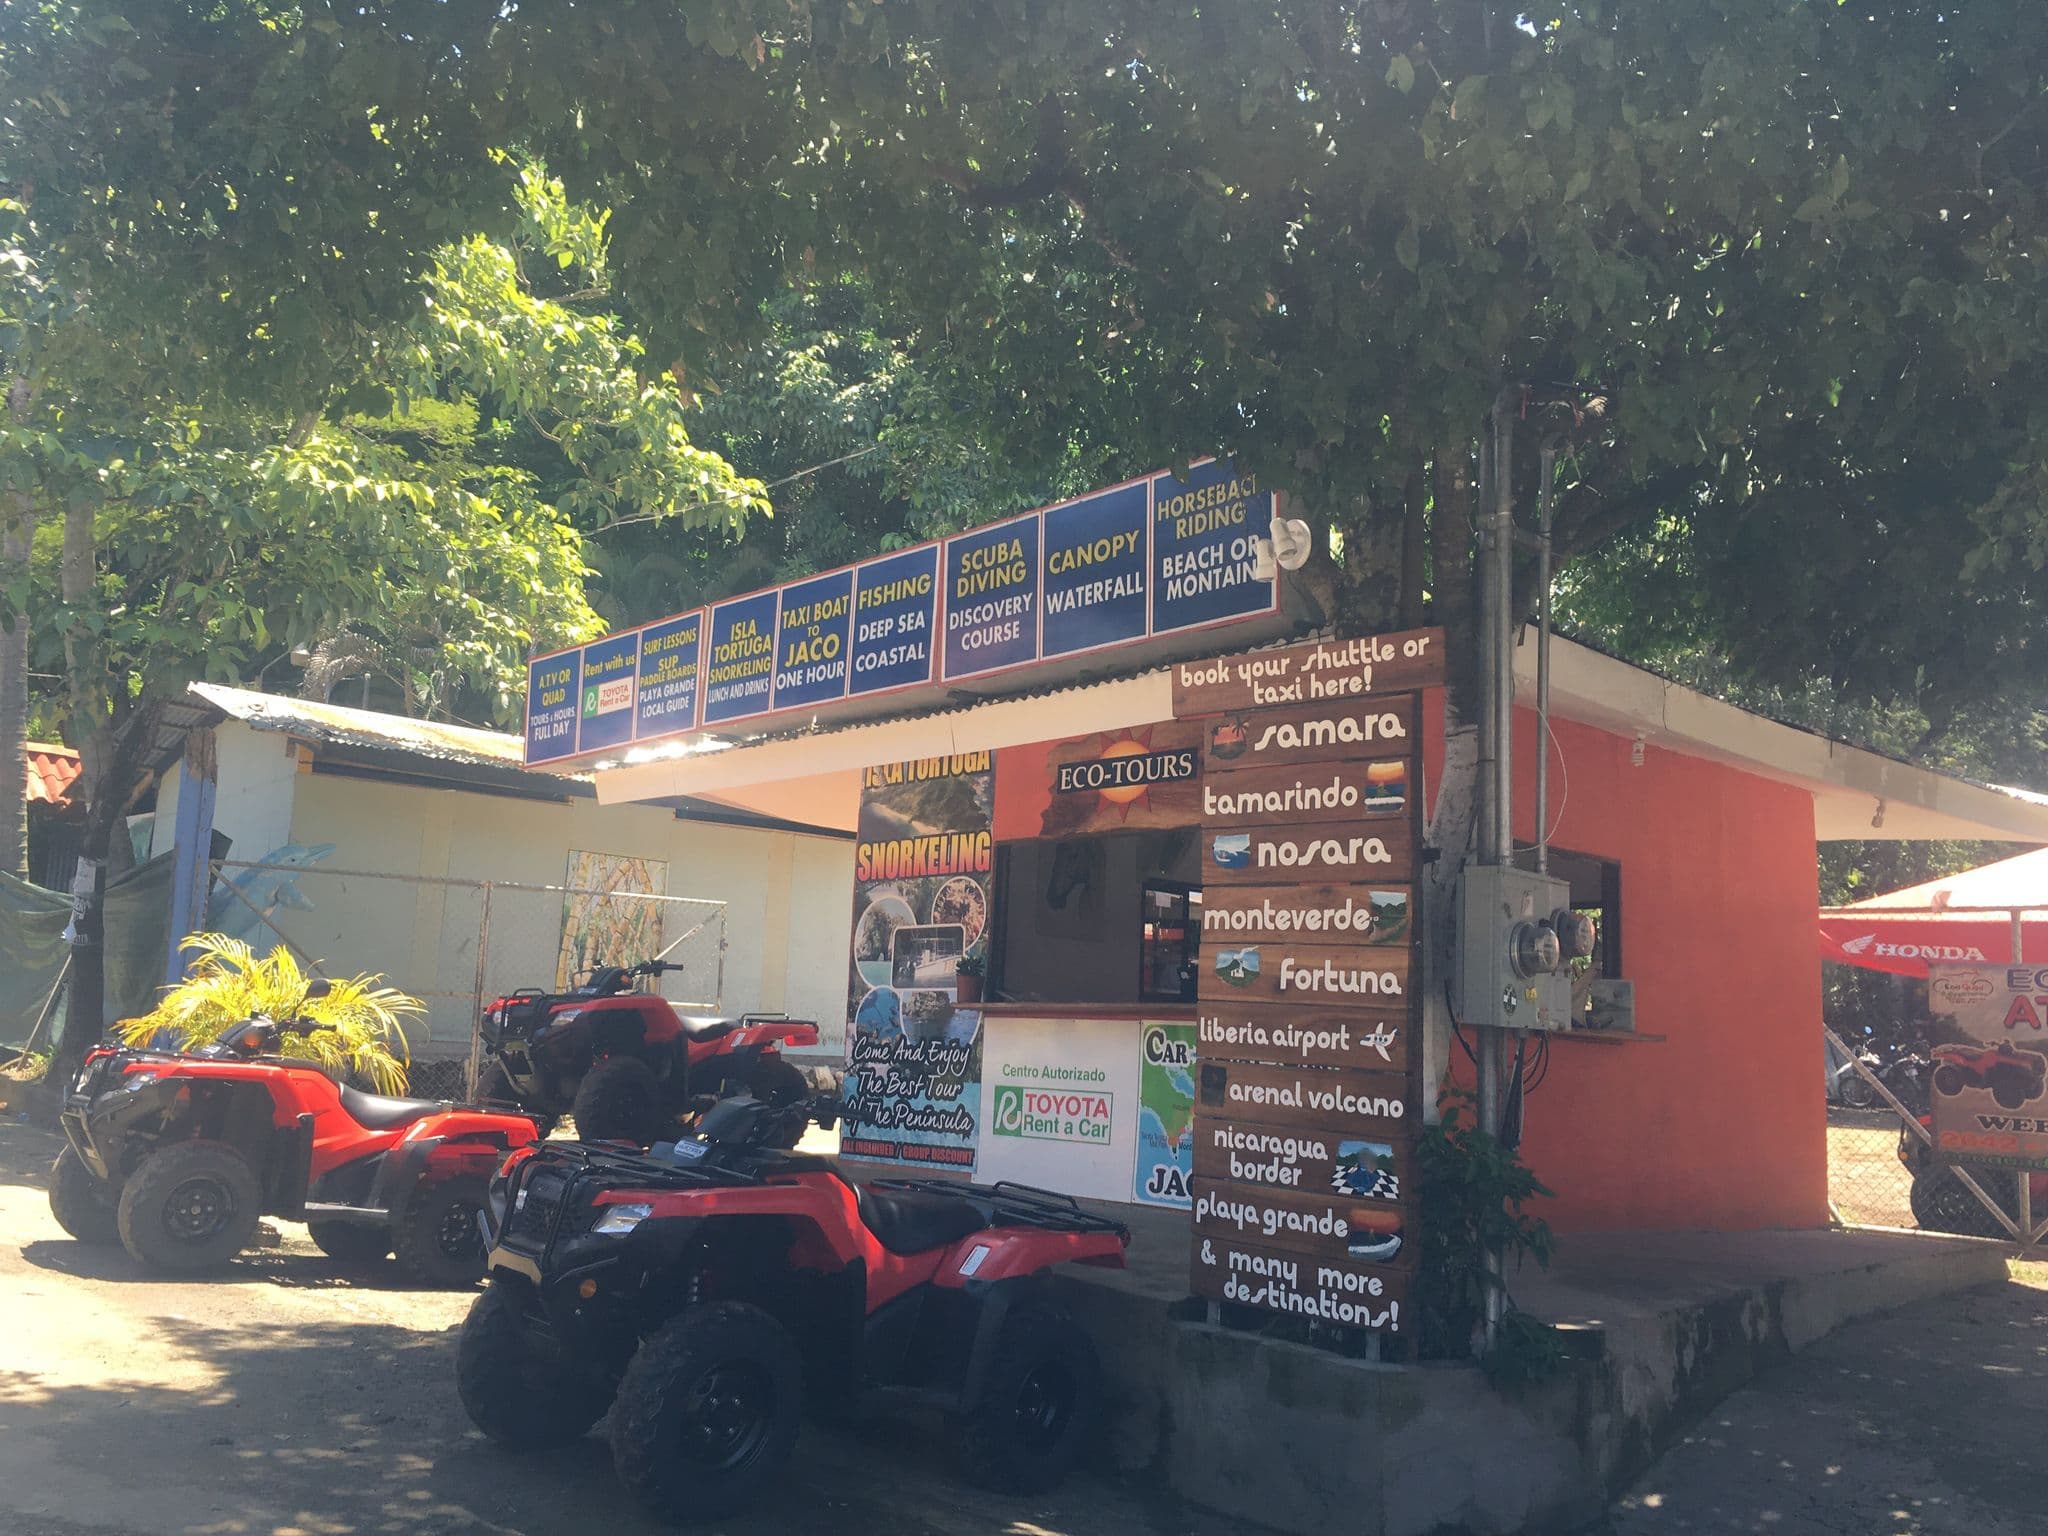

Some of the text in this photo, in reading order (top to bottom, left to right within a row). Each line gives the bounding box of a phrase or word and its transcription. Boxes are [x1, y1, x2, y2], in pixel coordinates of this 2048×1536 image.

[1157, 473, 1256, 522] HORSEBAC
[1175, 501, 1247, 540] RIDING
[961, 538, 1023, 574] SCUBA
[1048, 529, 1140, 576] CANOPY
[1162, 543, 1223, 579] BEACH
[858, 573, 931, 610] FISHING
[956, 560, 1027, 598] DIVING
[1046, 571, 1144, 616] WATERFALL
[782, 594, 849, 629] TAXI BOAT
[858, 610, 925, 643] DEEP SEA
[949, 592, 1033, 631] DISCOVERY
[644, 628, 697, 656] SURF LESSONS
[731, 619, 756, 641] ISLA
[807, 624, 820, 638] TO
[961, 620, 1020, 651] COURSE
[658, 655, 679, 672] SUP
[714, 634, 772, 663] TORTUGA
[784, 633, 840, 668] JACO
[855, 642, 925, 673] COASTAL
[1180, 636, 1430, 687] book your shuttle or
[559, 668, 571, 686] OR
[585, 653, 636, 678] Rent with us
[640, 663, 697, 688] PADDLE BOARDS
[710, 656, 771, 685] SNORKELING
[776, 660, 845, 691] ONE HOUR
[542, 688, 566, 707] QUAD
[602, 684, 629, 698] TOYOTA
[640, 678, 695, 703] PLAYA GRANDE
[708, 678, 769, 704] LUNCH AND DRINKS
[1253, 664, 1373, 704] taxi here!
[531, 713, 549, 727] TOURS
[642, 696, 690, 719] LOCAL GUIDE
[534, 720, 570, 741] FULL DAY
[1254, 712, 1406, 751] samara
[1060, 753, 1193, 791] ECO-TOURS
[1204, 776, 1359, 815] tamarindo
[857, 831, 991, 881] SNORKELING
[1257, 837, 1392, 867] nosara
[1203, 898, 1371, 931] monteverde
[1874, 942, 1988, 961] HONDA
[1200, 1016, 1350, 1057] liberia airport
[854, 1036, 970, 1077] Come And Enjoy
[1002, 1063, 1106, 1082] Centro Autorizado
[859, 1071, 961, 1097] The Best Tour
[1229, 1080, 1404, 1119] arenal volcano
[867, 1101, 891, 1125] The
[895, 1103, 972, 1131] Peninsula
[1024, 1092, 1110, 1119] TOYOTA
[1023, 1114, 1109, 1138] Rent a Car
[842, 1139, 855, 1153] ALL
[902, 1145, 931, 1160] GROUP
[931, 1148, 974, 1164] DISCOUNT
[1214, 1126, 1328, 1164] nicaragua
[1230, 1151, 1302, 1186] border
[1196, 1191, 1348, 1238] playa grande
[1200, 1239, 1383, 1297] & many more
[1223, 1272, 1399, 1332] destinations!
